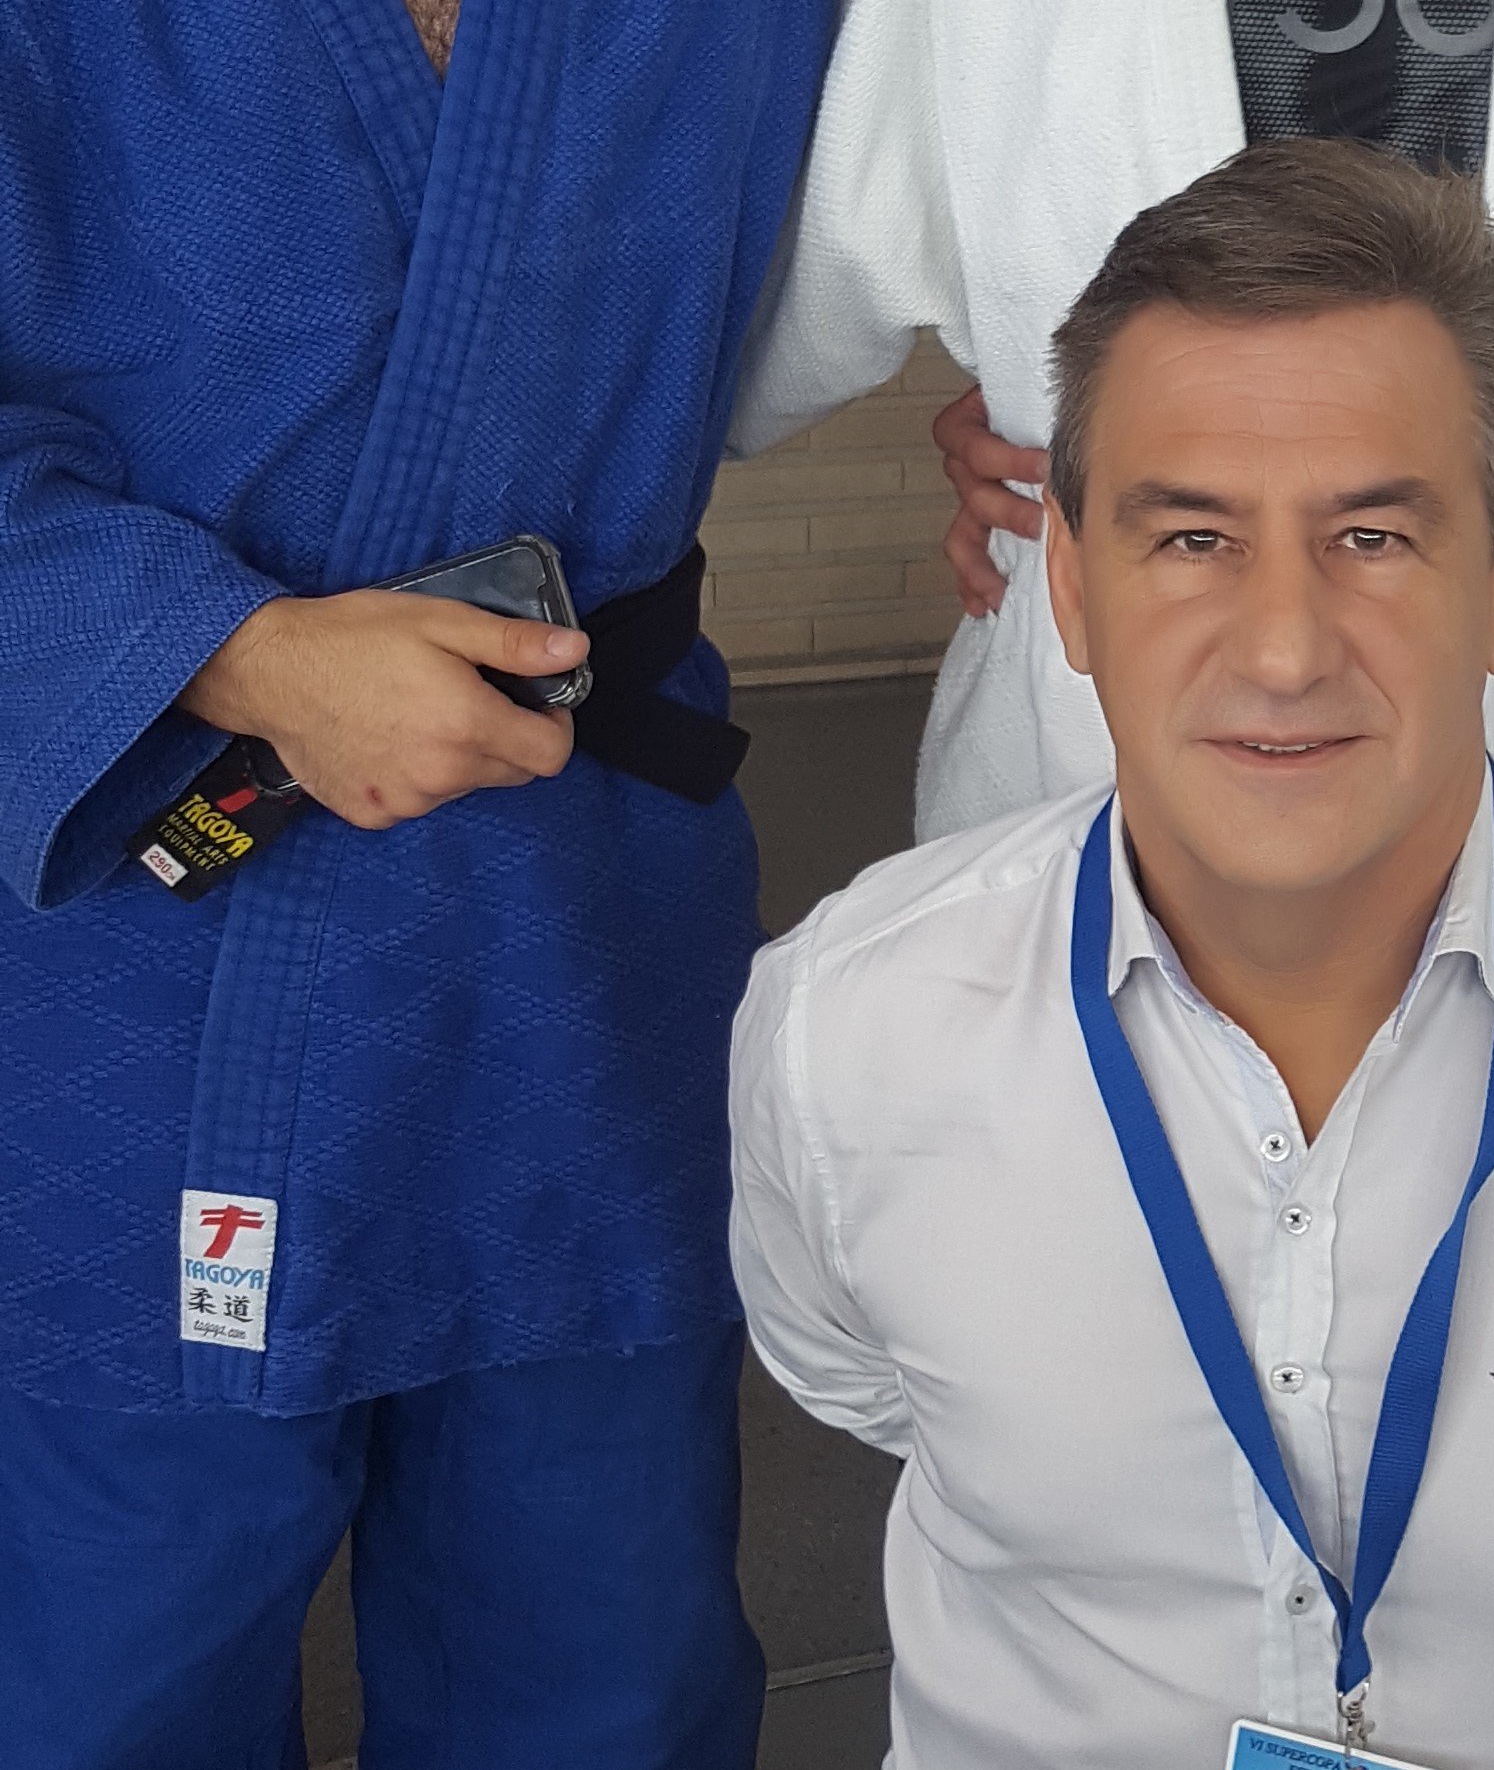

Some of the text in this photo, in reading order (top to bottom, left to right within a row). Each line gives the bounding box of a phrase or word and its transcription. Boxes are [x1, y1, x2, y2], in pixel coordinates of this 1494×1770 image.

[157, 824, 217, 872] EQUIPMENT
[166, 812, 229, 868] MARTIAL ARTS
[178, 793, 254, 859] TAGOYA
[184, 1257, 265, 1290] TAGOYA
[188, 1287, 254, 1323] 柔道
